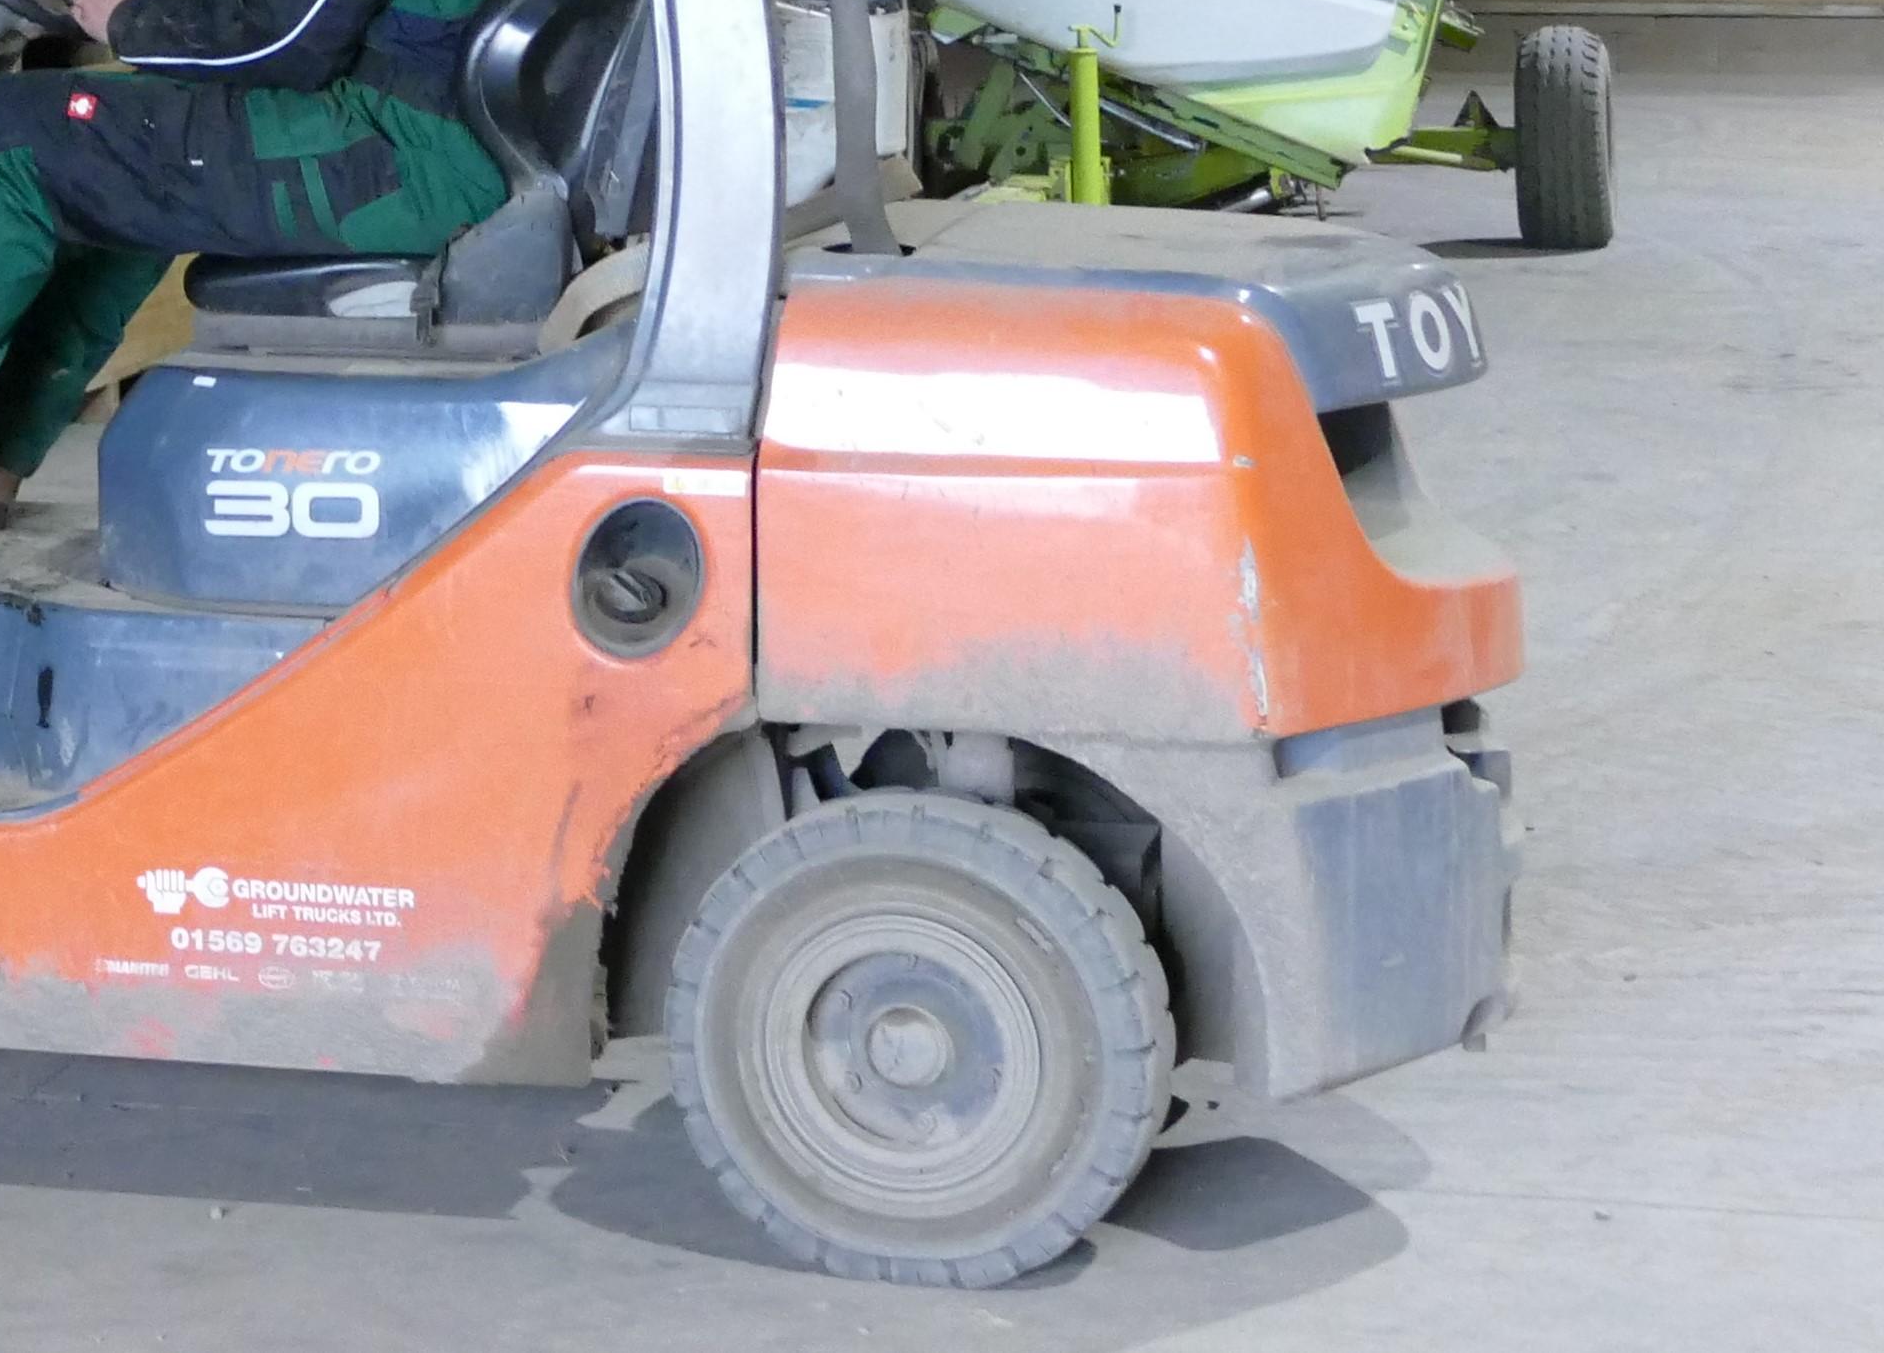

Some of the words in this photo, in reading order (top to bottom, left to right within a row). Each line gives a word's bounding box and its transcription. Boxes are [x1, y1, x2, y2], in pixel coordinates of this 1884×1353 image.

[205, 480, 379, 539] 30
[232, 878, 415, 910] GROUNDWATER
[252, 903, 287, 921] LIFT
[292, 905, 362, 925] TRUCKS
[365, 908, 403, 928] LTD.
[171, 927, 262, 954] 01569
[272, 934, 381, 962] 763247
[184, 964, 240, 984] GEHL
